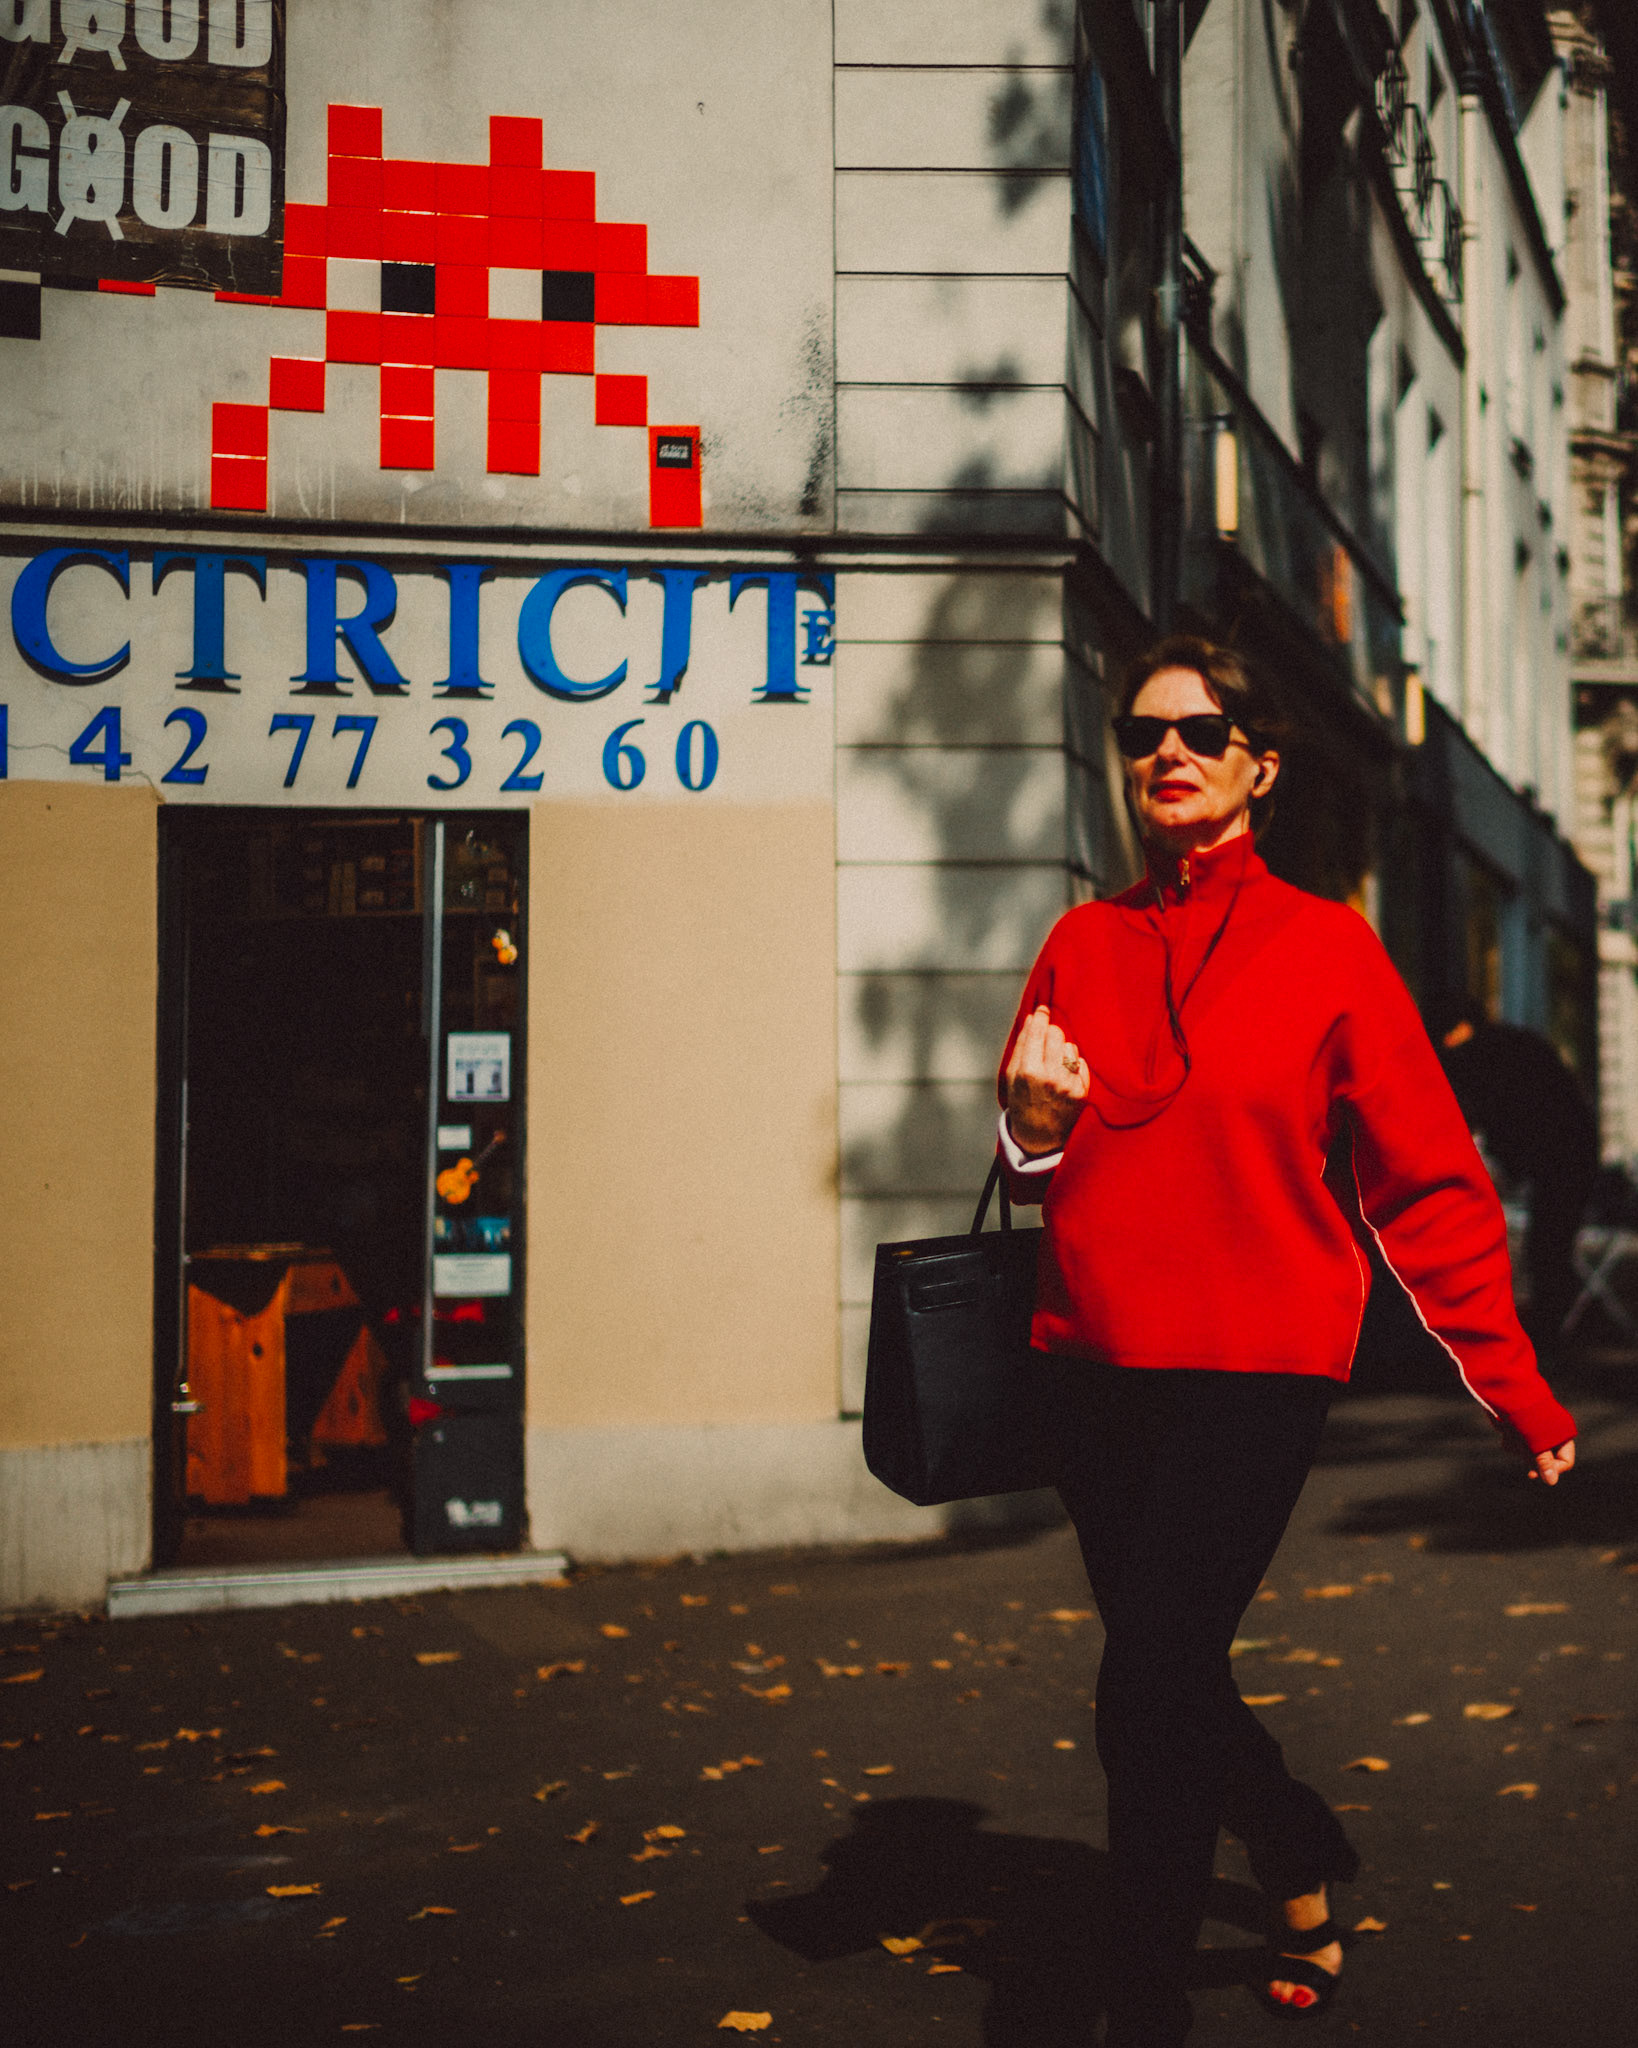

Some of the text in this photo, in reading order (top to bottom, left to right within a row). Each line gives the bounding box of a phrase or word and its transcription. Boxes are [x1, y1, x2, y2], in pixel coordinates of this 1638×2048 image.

[0, 90, 272, 240] GOOD
[70, 706, 209, 785] 42
[268, 713, 379, 789] 77
[427, 716, 544, 792] 32
[602, 718, 719, 792] 60
